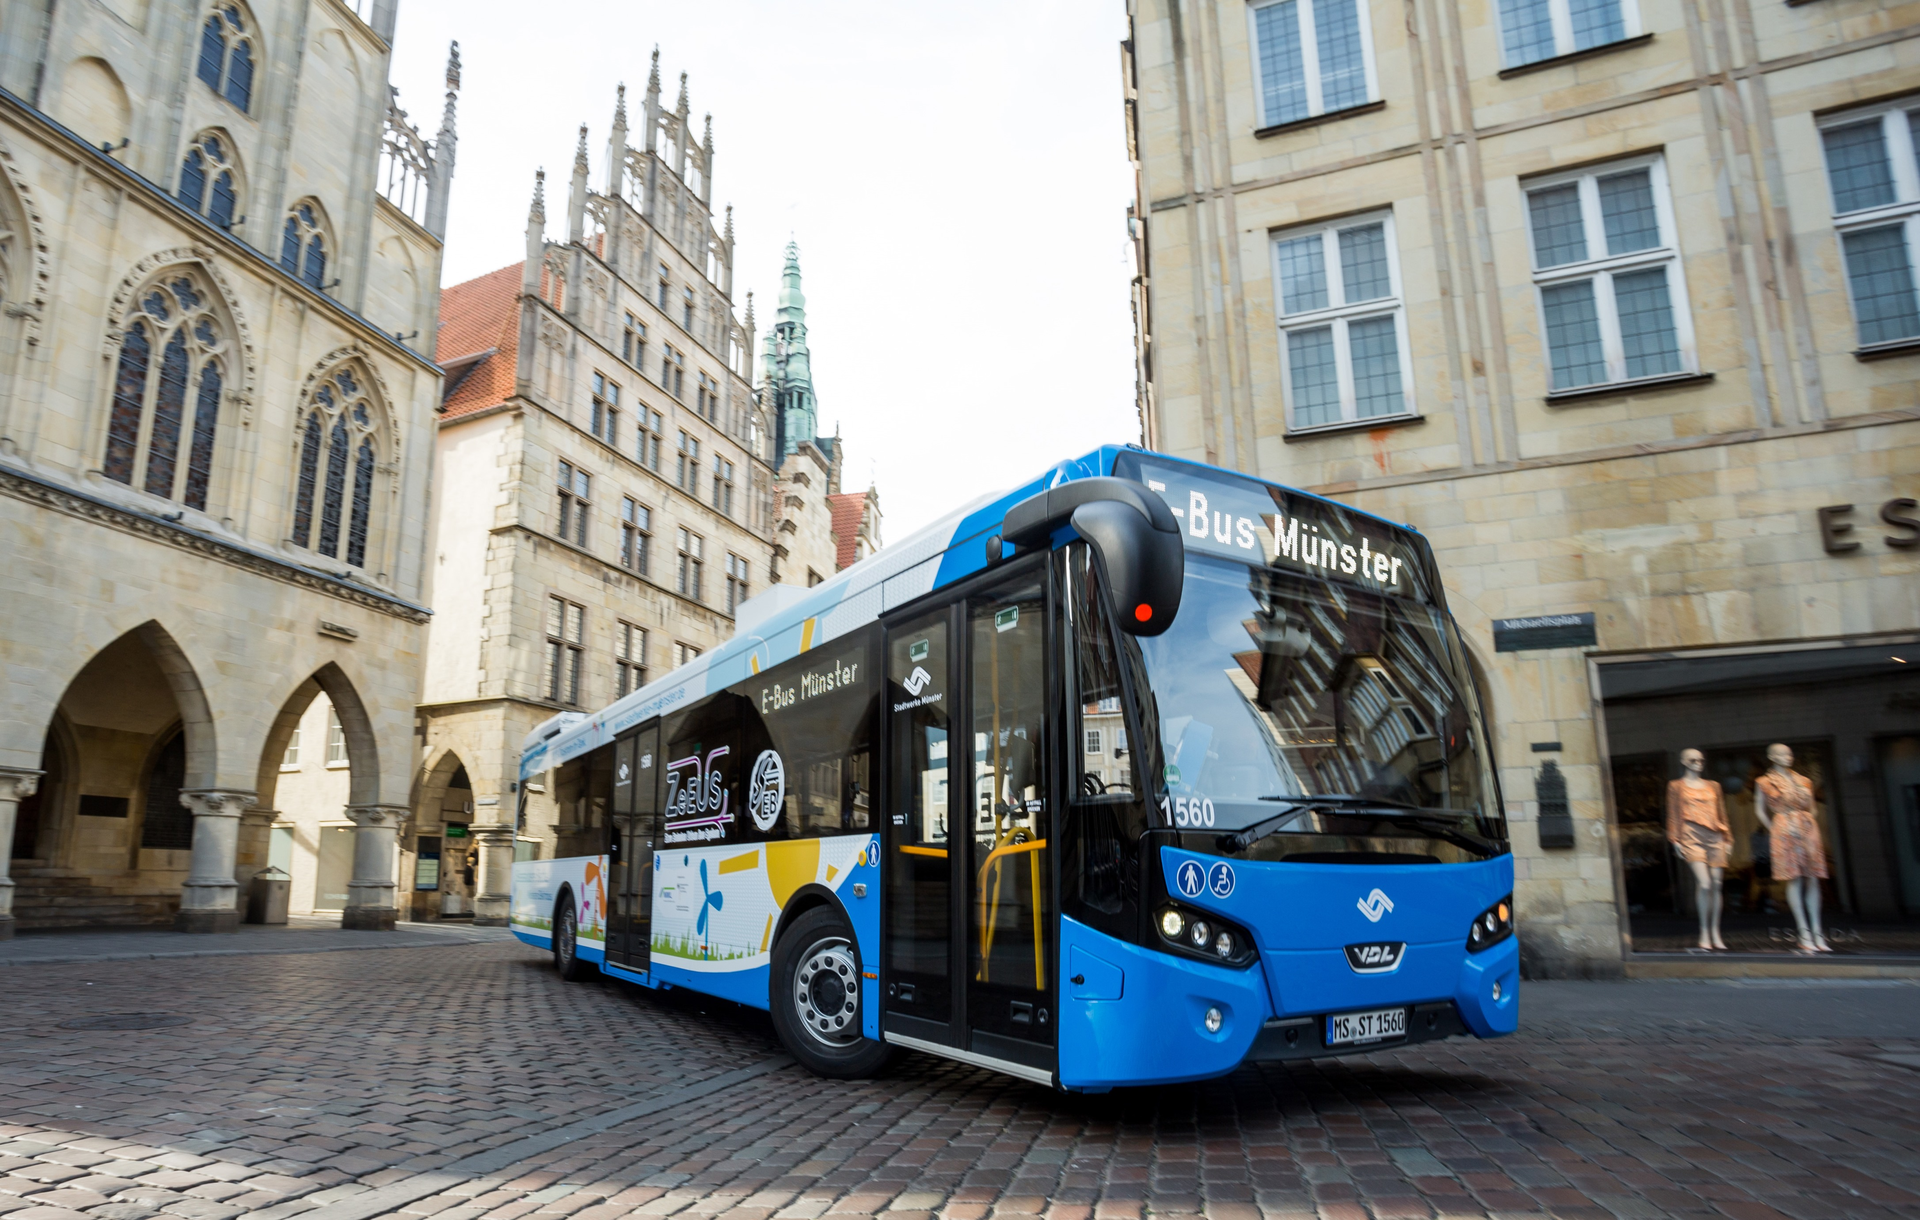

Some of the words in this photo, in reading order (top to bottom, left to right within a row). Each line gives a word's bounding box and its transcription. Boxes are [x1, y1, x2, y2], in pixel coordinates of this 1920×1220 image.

[1817, 498, 1920, 553] ES
[1274, 514, 1402, 585] Münster
[761, 684, 796, 714] E-Bus
[801, 659, 858, 700] Münster
[893, 698, 921, 712] Stadtwerke
[921, 693, 943, 705] Münster
[1160, 796, 1215, 828] 1560
[1354, 946, 1394, 964] VDL
[1334, 1016, 1350, 1040] MS
[1358, 1014, 1373, 1036] ST
[1376, 1011, 1404, 1034] 1560
